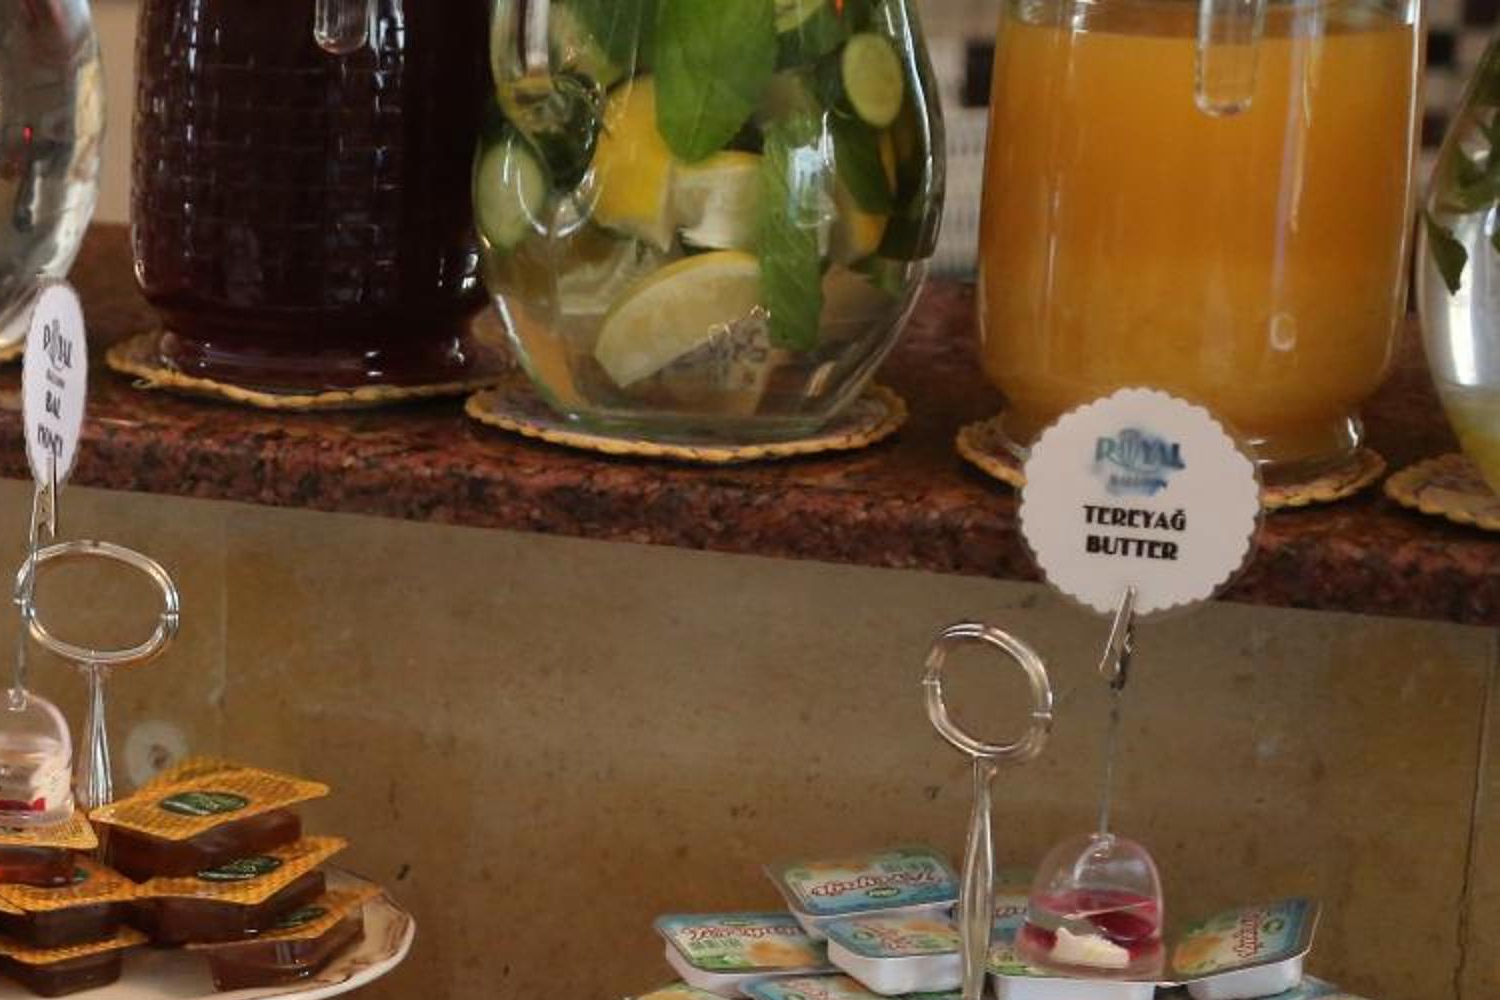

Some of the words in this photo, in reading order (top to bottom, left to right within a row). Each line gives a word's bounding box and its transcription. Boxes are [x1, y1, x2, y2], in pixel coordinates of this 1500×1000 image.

[1095, 427, 1187, 471] ROYAL
[1083, 504, 1188, 532] TEREYAĞ
[1086, 534, 1180, 561] BUTTER
